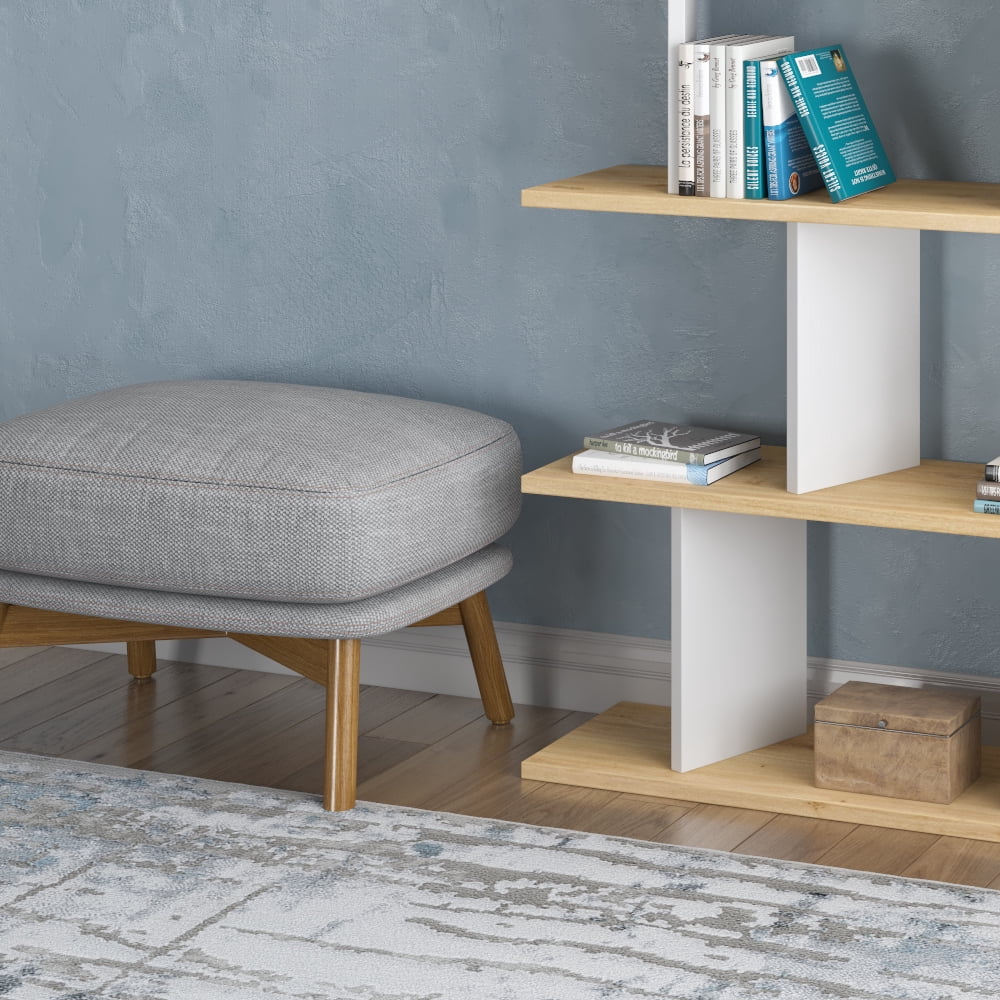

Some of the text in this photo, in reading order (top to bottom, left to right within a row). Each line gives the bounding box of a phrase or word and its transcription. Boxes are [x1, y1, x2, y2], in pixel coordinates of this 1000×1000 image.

[679, 84, 691, 105] destin
[679, 118, 695, 158] persistance
[746, 146, 759, 190] SILENT VOICES
[812, 144, 841, 193] SILENT VOICES
[638, 447, 678, 463] mockingbird
